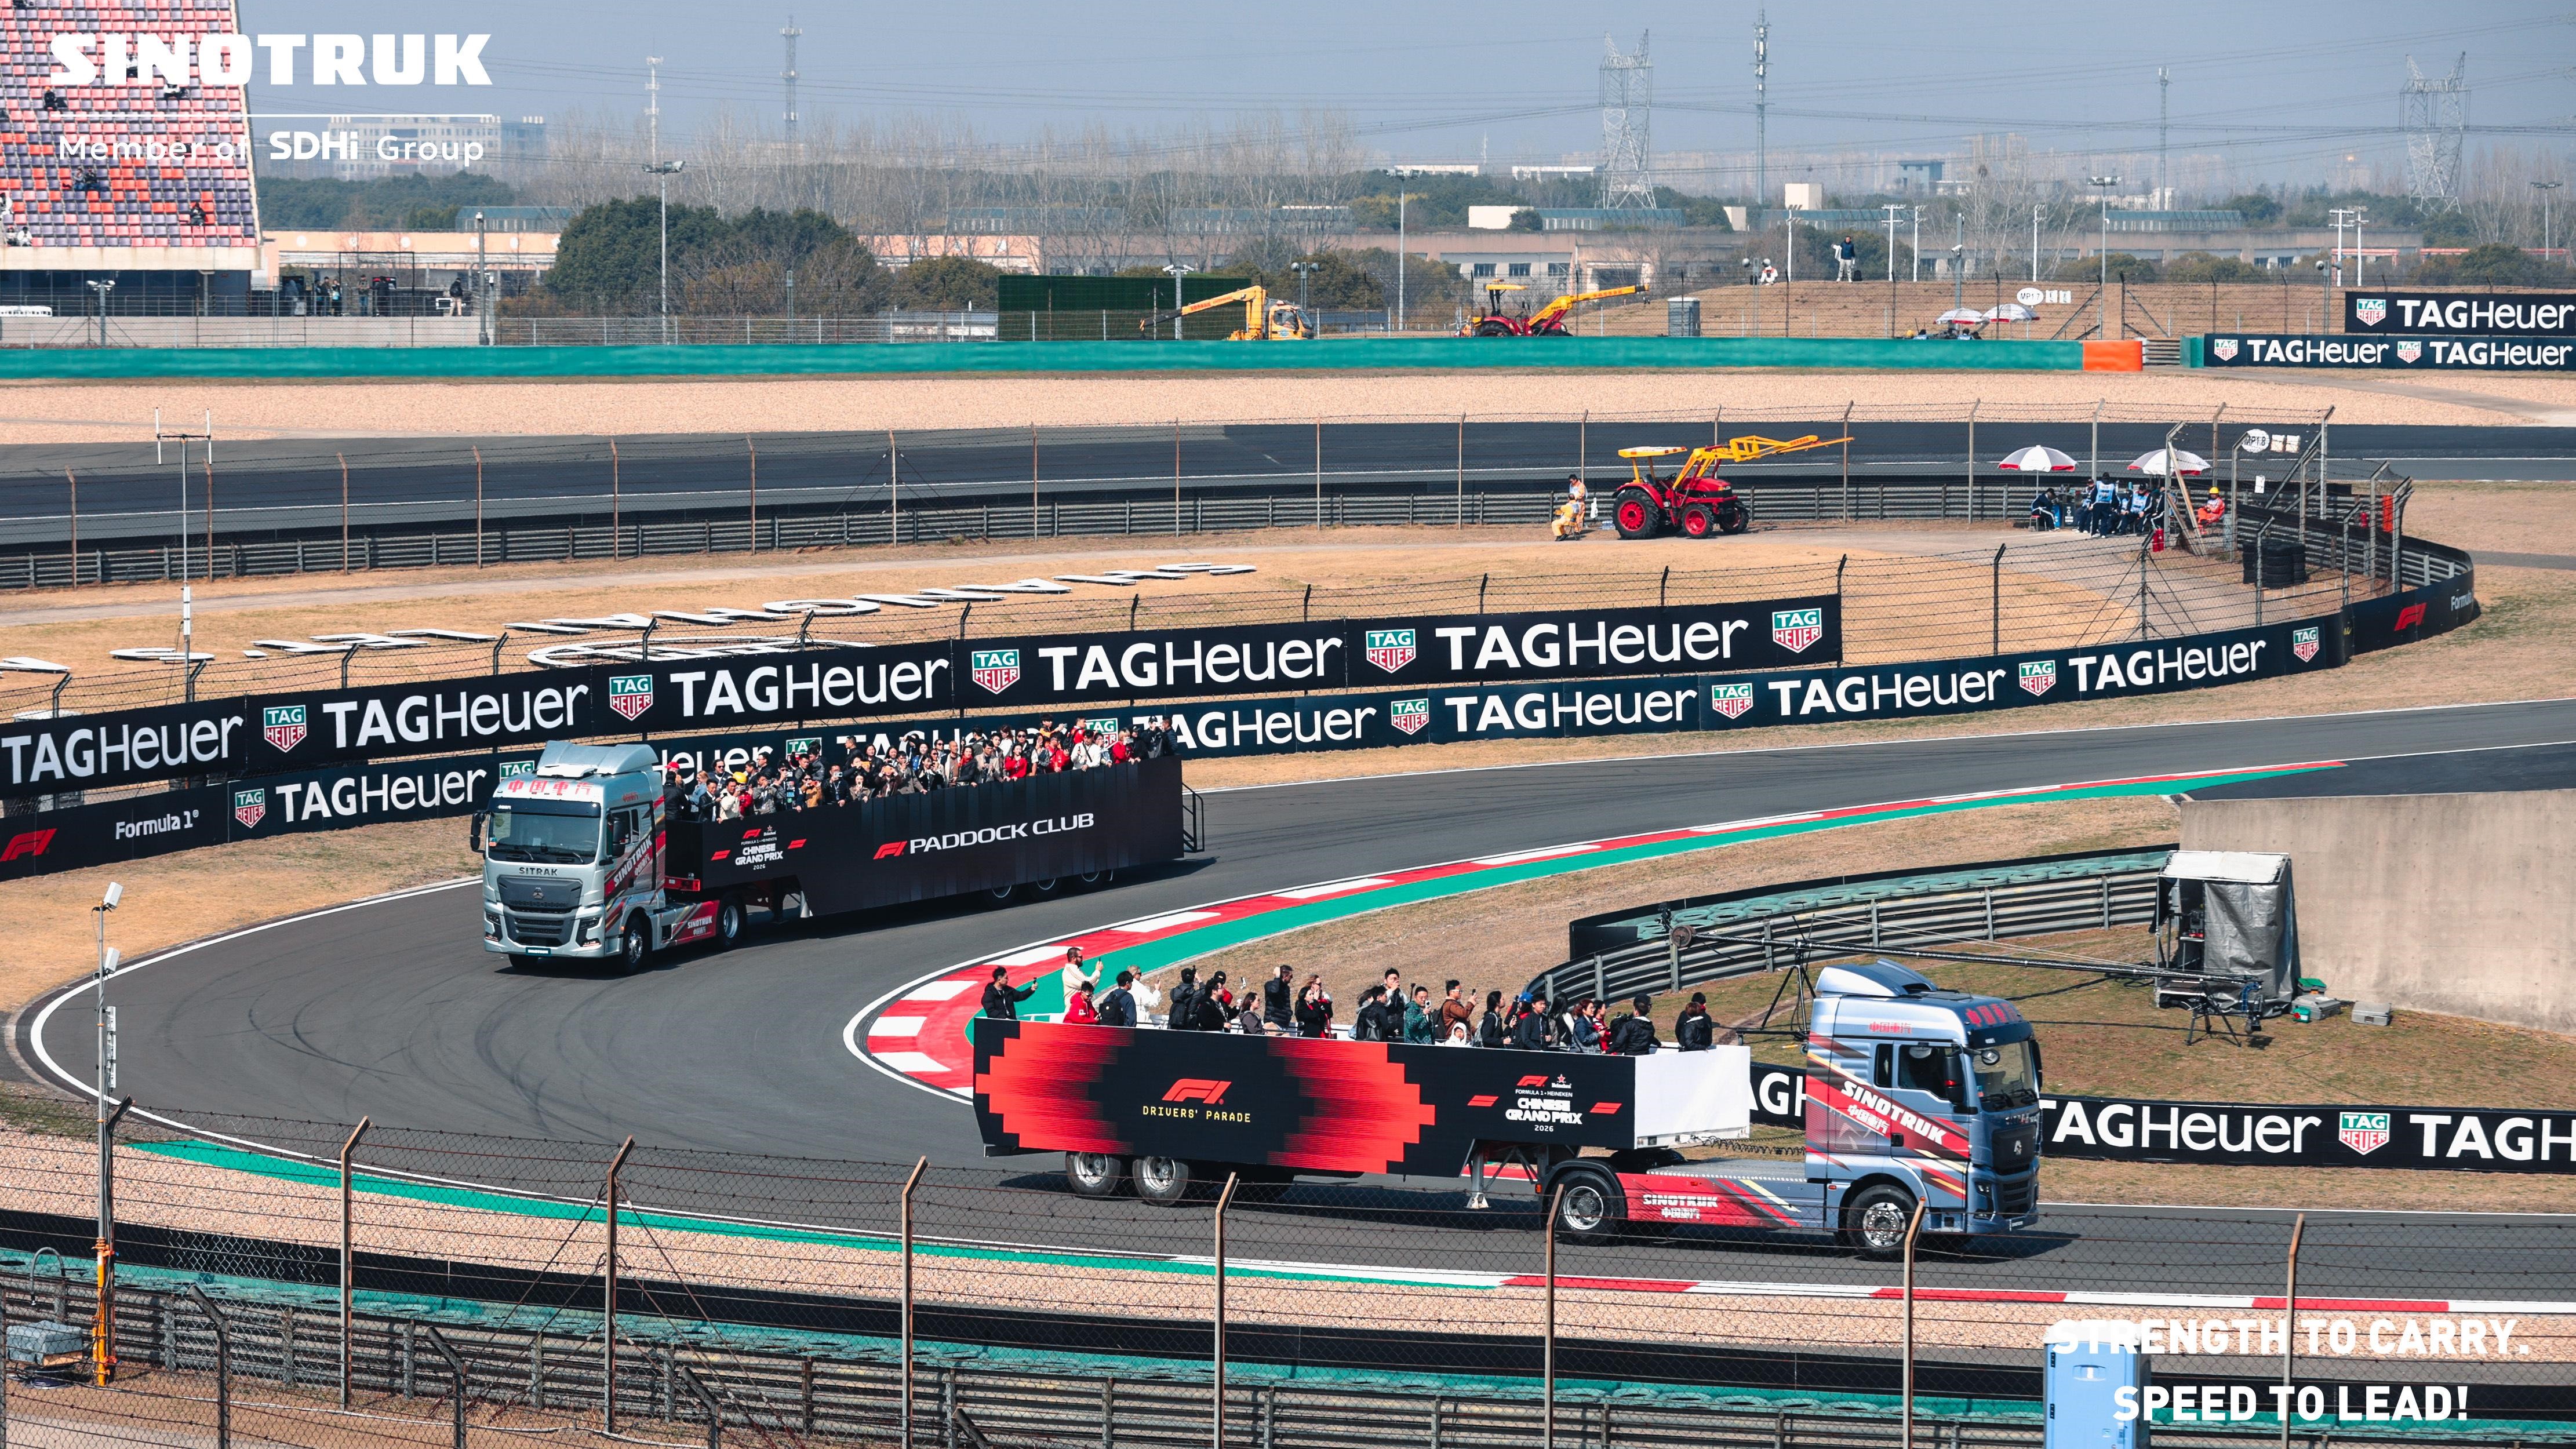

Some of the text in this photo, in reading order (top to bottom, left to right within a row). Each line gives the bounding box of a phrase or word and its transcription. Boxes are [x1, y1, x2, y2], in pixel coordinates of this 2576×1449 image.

[2359, 300, 2384, 310] TAG
[2358, 311, 2385, 323] HEUER
[2397, 300, 2575, 329] TAGHeuer
[2215, 348, 2237, 359] HEUER
[2247, 339, 2389, 363] TAGHeuer
[2399, 342, 2420, 350] TAG
[2429, 341, 2573, 366] TAGHeuer
[2399, 351, 2421, 361] HEUER
[1776, 610, 1820, 626] TAG
[1369, 631, 1413, 645] TAG
[1774, 627, 1821, 652] HEUER
[2295, 628, 2316, 641] TAG
[1436, 620, 1748, 669] TAGHeuer
[2294, 642, 2317, 658] HEUER
[976, 651, 1015, 667] TAG
[1039, 637, 1343, 689] TAGHeuer
[1367, 647, 1414, 671] HEUER
[2069, 640, 2265, 691] TAGHeuer
[2021, 662, 2053, 674] TAG
[614, 677, 648, 691] TAG
[671, 658, 949, 716] TAGHeuer
[974, 668, 1018, 690] HEUER
[2021, 675, 2054, 693] HEUER
[1715, 685, 1751, 697] TAG
[1769, 669, 2006, 715] TAGHeuer
[612, 694, 652, 717] HEUER
[1395, 701, 1427, 713] TAG
[1446, 690, 1697, 731] TAGHeuer
[1713, 698, 1751, 716] HEUER
[268, 708, 302, 724] TAG
[323, 685, 588, 748] TAGHeuer
[1393, 715, 1428, 731] HEUER
[1086, 721, 1114, 733] TAG
[265, 726, 305, 749] HEUER
[2, 715, 243, 784] TAGHeuer
[503, 763, 532, 776] TAG
[238, 791, 262, 804] TAG
[275, 770, 487, 822] TAGHeuer
[237, 805, 264, 824] HEUER
[116, 814, 180, 839] Formula
[910, 822, 1028, 854] PADDOCK
[1032, 813, 1094, 835] CLUB
[743, 843, 776, 855] CHINESE
[613, 835, 653, 887] SINOTRUK
[735, 851, 783, 865] GRAND PRIX
[519, 867, 558, 876] SITRAK
[687, 916, 712, 929] SINOTRUK
[1518, 1097, 1570, 1112] CHINESE
[1841, 1080, 1946, 1145] SINOTRUK
[1143, 1106, 1251, 1123] DRIVERS' PARADE
[1505, 1109, 1582, 1124] GRAND PRIX
[1847, 1104, 1890, 1134] 中国重汽
[2343, 1114, 2386, 1129] TAG
[2037, 1099, 2322, 1153] AGHeuer
[2341, 1130, 2387, 1149] HEUER
[1643, 1194, 1718, 1207] SINOTRUK
